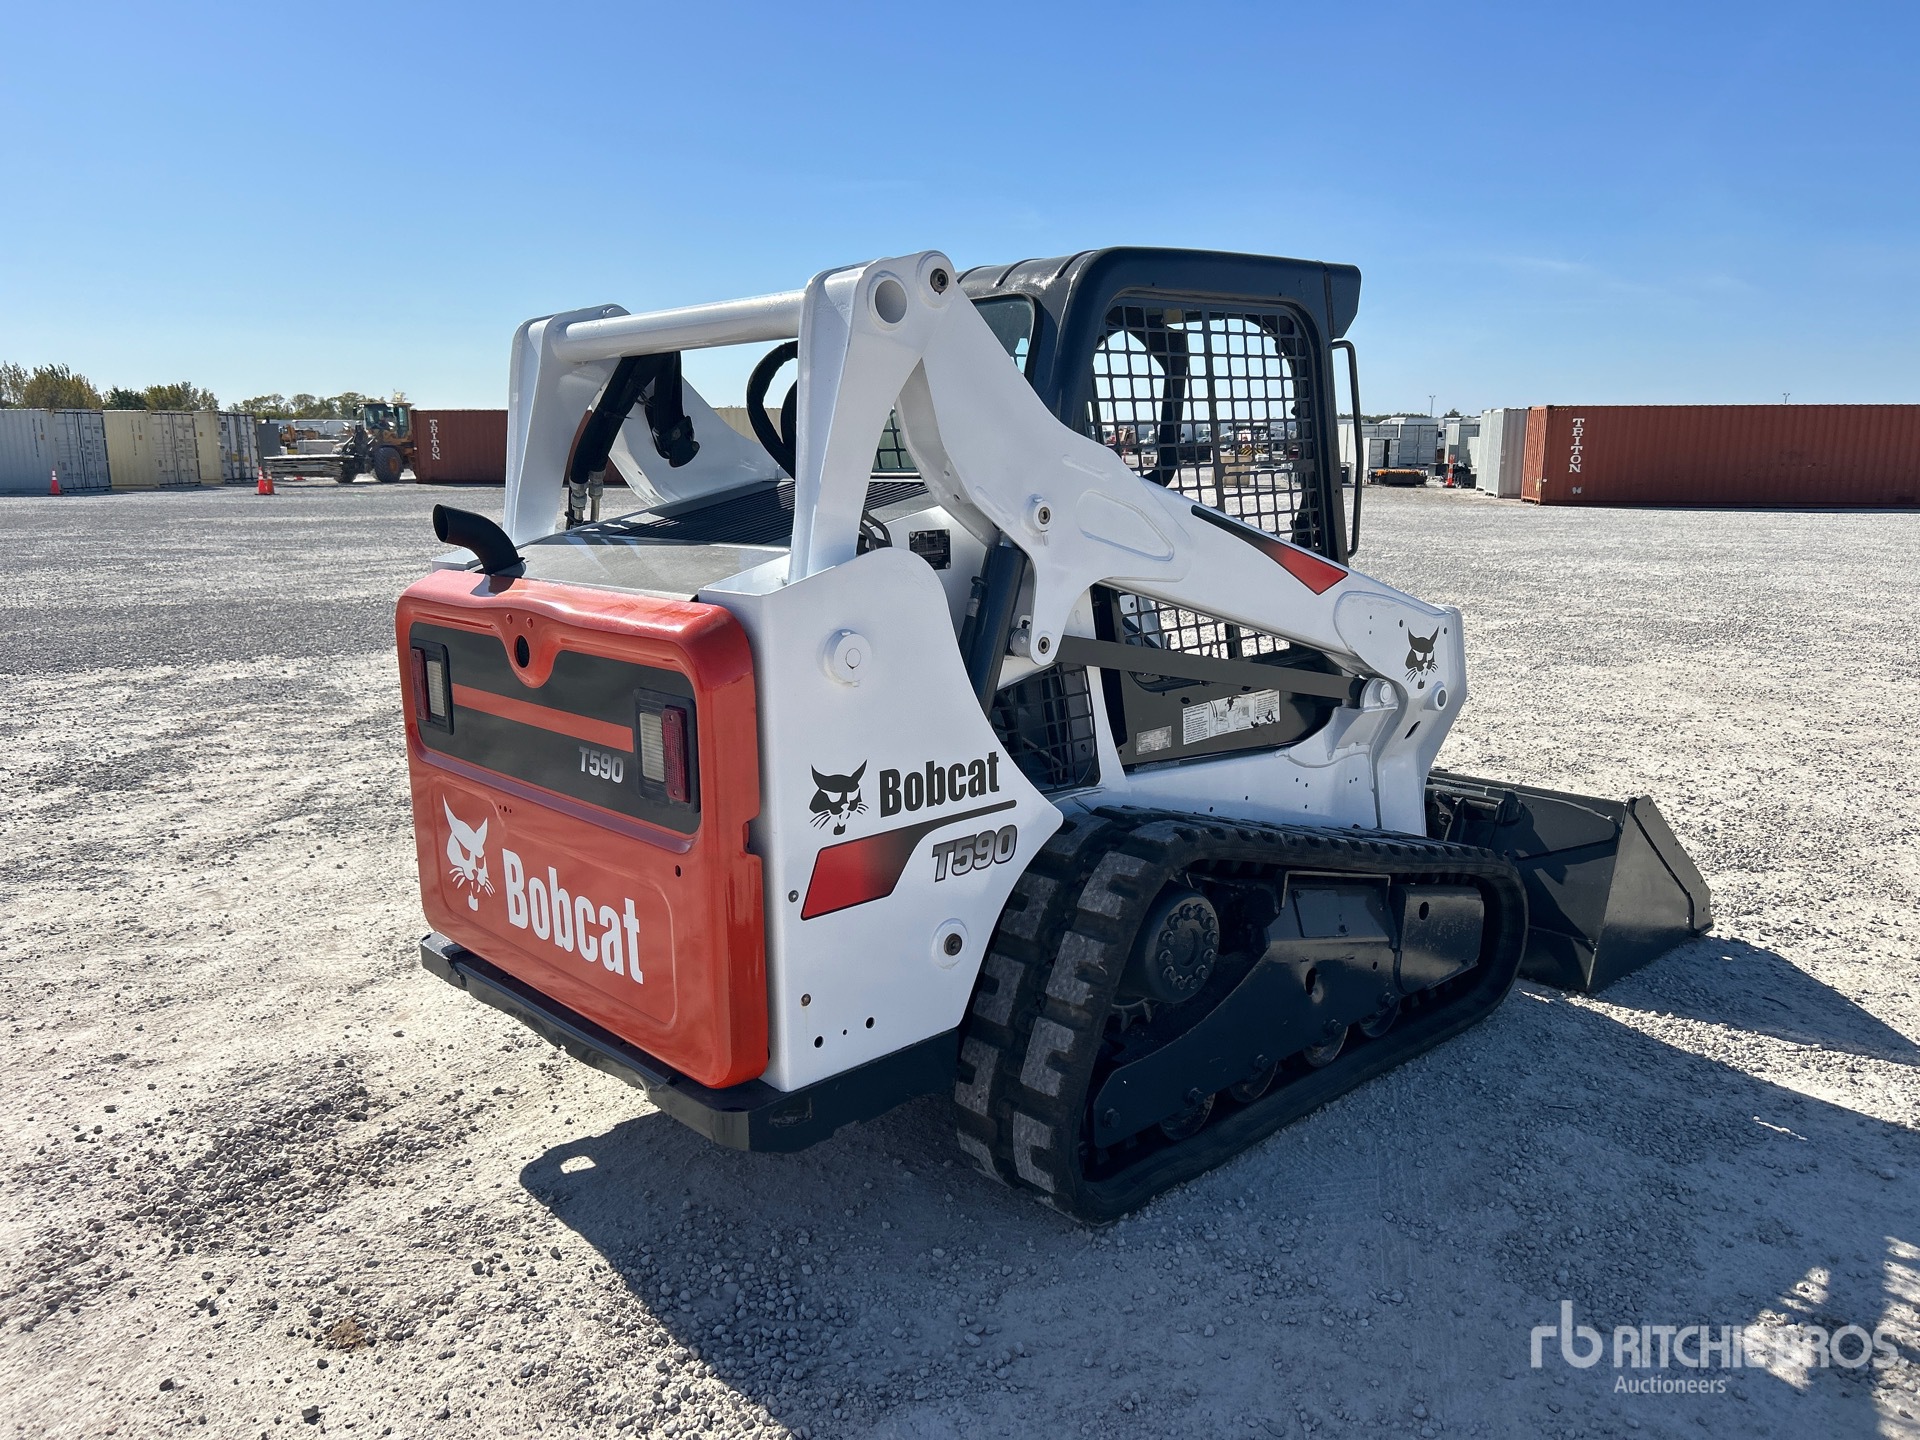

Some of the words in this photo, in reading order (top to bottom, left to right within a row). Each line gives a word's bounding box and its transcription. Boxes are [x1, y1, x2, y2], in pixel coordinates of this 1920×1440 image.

[429, 419, 441, 460] TRITON
[1568, 418, 1585, 473] TRITON
[579, 746, 625, 784] T590
[879, 751, 1000, 818] Bobcat
[931, 824, 1018, 883] T590
[501, 847, 644, 985] Bobcat
